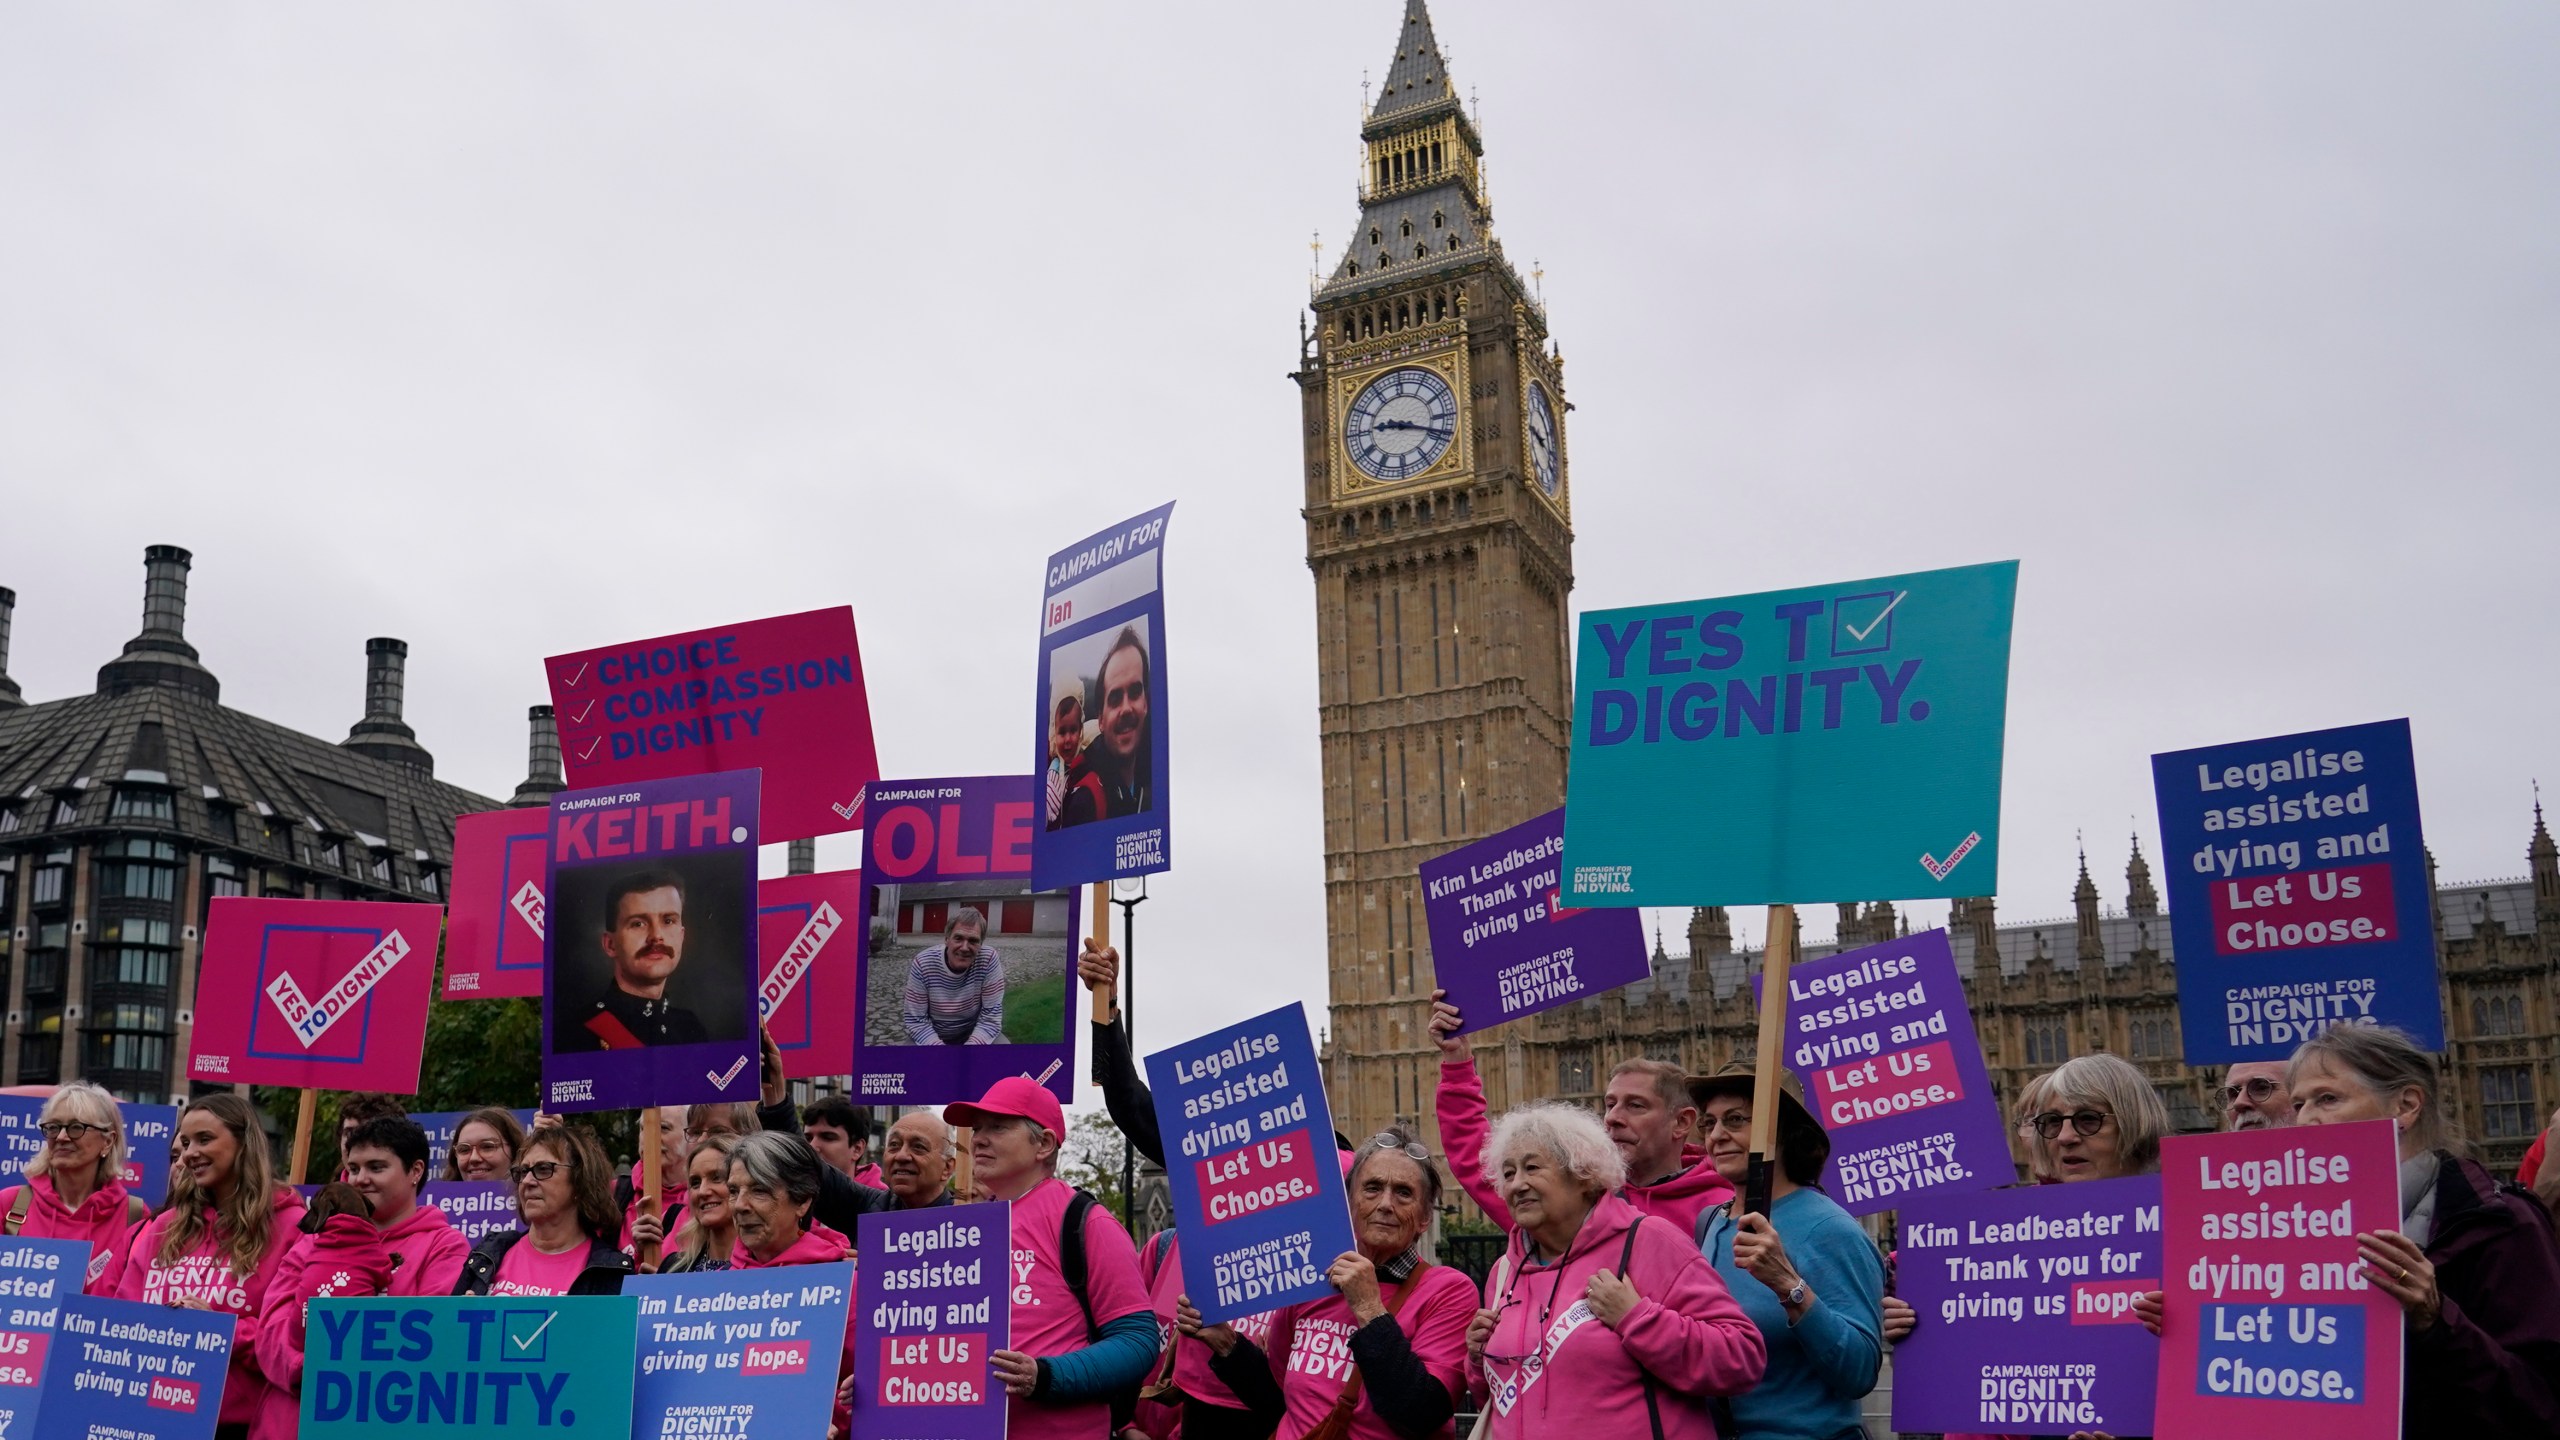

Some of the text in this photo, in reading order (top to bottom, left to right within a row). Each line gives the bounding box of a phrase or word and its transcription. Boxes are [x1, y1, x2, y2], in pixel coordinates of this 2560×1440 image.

[1049, 518, 1163, 588] CAMPAIGN FOR
[1049, 598, 1072, 628] Ian
[598, 636, 740, 686] CHOICE
[1594, 610, 1744, 679] YES
[604, 655, 853, 722] COMPASSION
[1589, 659, 1931, 746] DIGNITY.
[610, 707, 765, 760] DIGNITY
[2199, 748, 2364, 791] Legalise
[560, 792, 641, 810] CAMPAIGN FOR
[875, 788, 961, 800] CAMPAIGN FOR
[2203, 784, 2369, 831] assisted
[556, 797, 748, 862] KEITH.
[873, 802, 1033, 878] OLE
[1116, 828, 1161, 843] CAMPAIGN FOR
[1116, 837, 1161, 857] DIGNITY
[1116, 851, 1164, 870] IN DYING.
[1924, 855, 1938, 872] YES
[2193, 823, 2390, 877] dying and
[1429, 874, 1466, 900] Kim
[1460, 881, 1516, 916] Thank
[1522, 868, 1556, 898] you
[1574, 872, 1631, 882] DIGNITY
[1574, 882, 1634, 893] IN DYING.
[2228, 872, 2362, 910] Let Us
[1463, 915, 1518, 948] giving
[1524, 902, 1546, 923] us
[2228, 916, 2386, 950] Choose.
[450, 976, 479, 985] DIGNITY
[1498, 948, 1574, 980] CAMPAIGN FOR
[1500, 957, 1575, 996] DIGNITY
[1790, 956, 1917, 1002] Legalise
[276, 979, 308, 1022] YES
[448, 984, 456, 992] IN
[1502, 975, 1585, 1014] IN DYING.
[2226, 978, 2376, 1001] CAMPAIGN FOR
[1799, 981, 1926, 1032] assisted
[2227, 992, 2376, 1024] DIGNITY
[1795, 1010, 1948, 1067] dying and
[2230, 1023, 2263, 1046] IN
[196, 1058, 229, 1068] DIGNITY
[204, 1066, 230, 1074] DYING.
[1174, 1033, 1280, 1085] Legalise
[1826, 1052, 1931, 1092] Let Us
[552, 1084, 592, 1095] DIGNITY
[710, 1072, 720, 1084] YES
[862, 1078, 904, 1086] DIGNITY
[862, 1086, 906, 1094] IN DYING.
[1184, 1062, 1289, 1120] assisted
[552, 1092, 595, 1103] IN DYING.
[1830, 1083, 1956, 1124] Choose.
[134, 1122, 168, 1138] MP:
[1182, 1094, 1307, 1157] dying and
[1207, 1140, 1294, 1185] Let Us
[1837, 1132, 1954, 1167] CAMPAIGN FOR
[1840, 1143, 1956, 1186] DIGNITY
[1844, 1162, 1972, 1203] IN DYING.
[2200, 1148, 2350, 1196] Legalise
[426, 1192, 516, 1216] Legalise
[1210, 1176, 1313, 1220] Choose.
[1908, 1223, 1958, 1248] Kim
[1969, 1211, 2124, 1244] Leadbeater
[2201, 1199, 2352, 1240] assisted
[884, 1221, 981, 1257] Legalise
[1214, 1231, 1311, 1267] CAMPAIGN FOR
[145, 1266, 255, 1289] DIGNITY
[883, 1258, 980, 1290] assisted
[1215, 1243, 1311, 1288] DIGNITY
[1946, 1248, 2142, 1283] Thank you for
[2188, 1254, 2368, 1298] dying and
[674, 1285, 842, 1315] Leadbeater MP:
[1218, 1264, 1324, 1306] IN DYING.
[10, 1307, 58, 1328] and
[873, 1296, 990, 1334] dying and
[1942, 1292, 2023, 1324] giving
[2034, 1295, 2066, 1314] us
[2215, 1306, 2337, 1344] Let Us
[63, 1313, 227, 1353] Kim Leadbeater MP:
[318, 1310, 434, 1362] YES
[653, 1318, 801, 1344] Thank you for
[83, 1342, 196, 1376] Thank you for
[642, 1345, 805, 1374] giving us hope.
[890, 1337, 969, 1364] Let Us
[1982, 1364, 2096, 1378] CAMPAIGN FOR
[2207, 1357, 2354, 1400] Choose.
[74, 1372, 196, 1406] giving us hope.
[314, 1371, 577, 1427] DIGNITY.
[886, 1377, 979, 1402] Choose.
[1981, 1378, 2095, 1400] DIGNITY
[662, 1416, 752, 1434] DIGNITY
[666, 1405, 754, 1416] CAMPAIGN FOR
[1980, 1401, 2103, 1424] IN DYING.
[90, 1424, 135, 1440] CAMPAIGN
